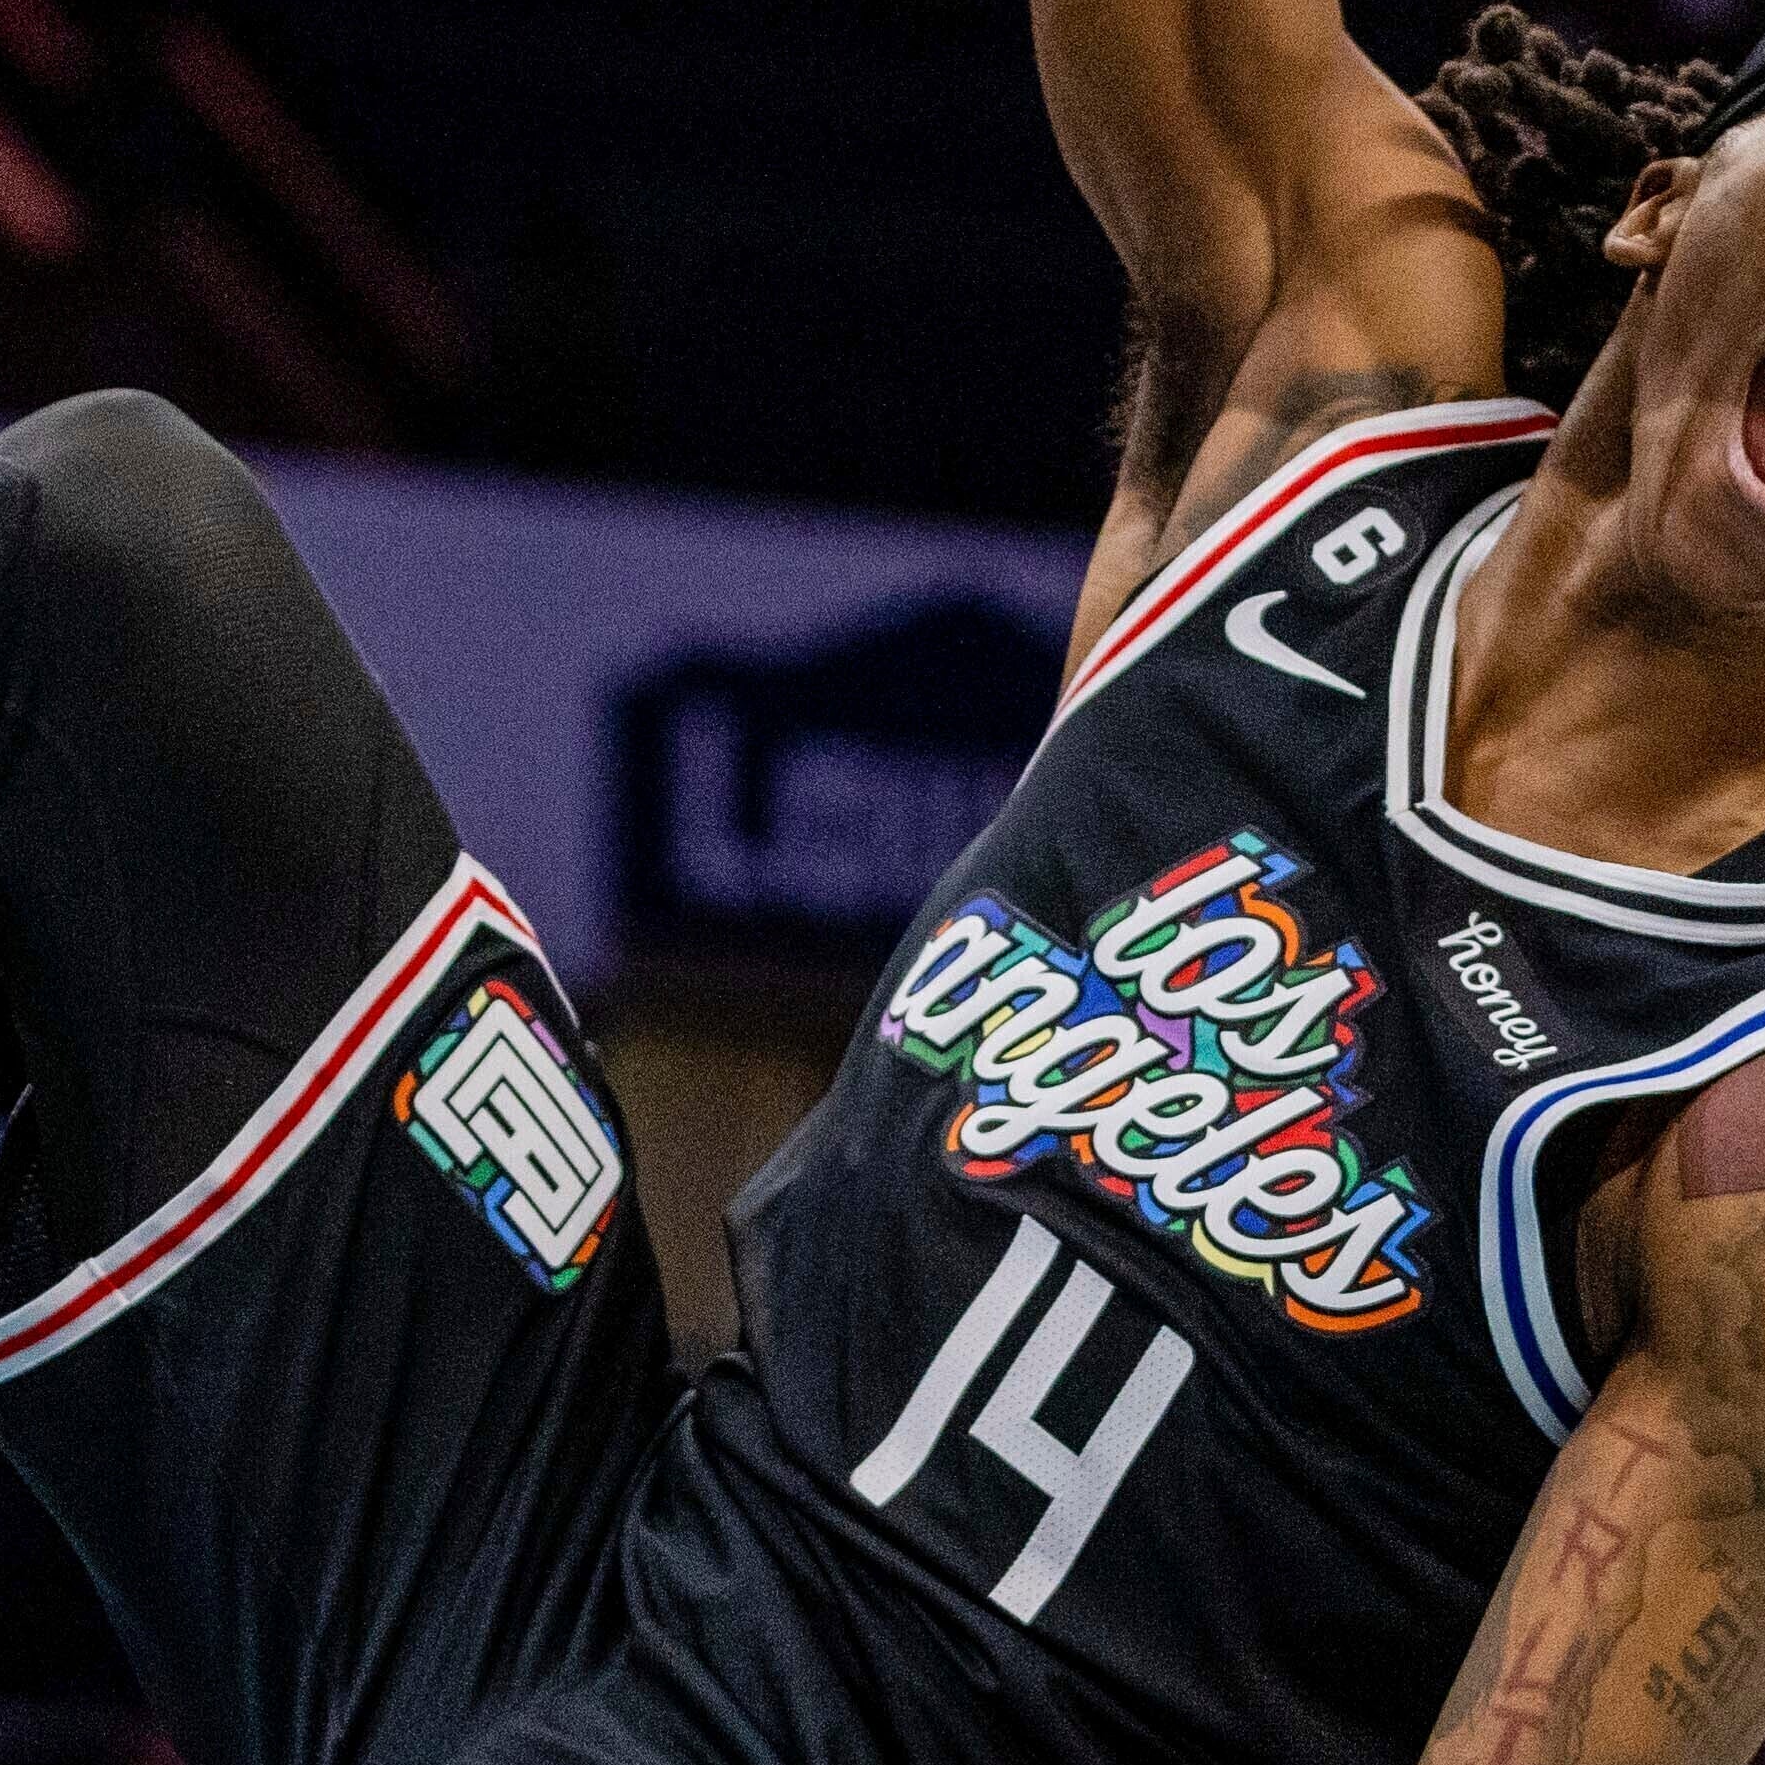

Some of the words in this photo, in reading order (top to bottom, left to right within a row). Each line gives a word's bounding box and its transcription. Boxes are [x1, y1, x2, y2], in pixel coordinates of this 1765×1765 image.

[1309, 505, 1407, 586] 6
[888, 913, 1408, 1314] angeles
[1437, 911, 1558, 1071] honey
[850, 1213, 1195, 1626] 14
